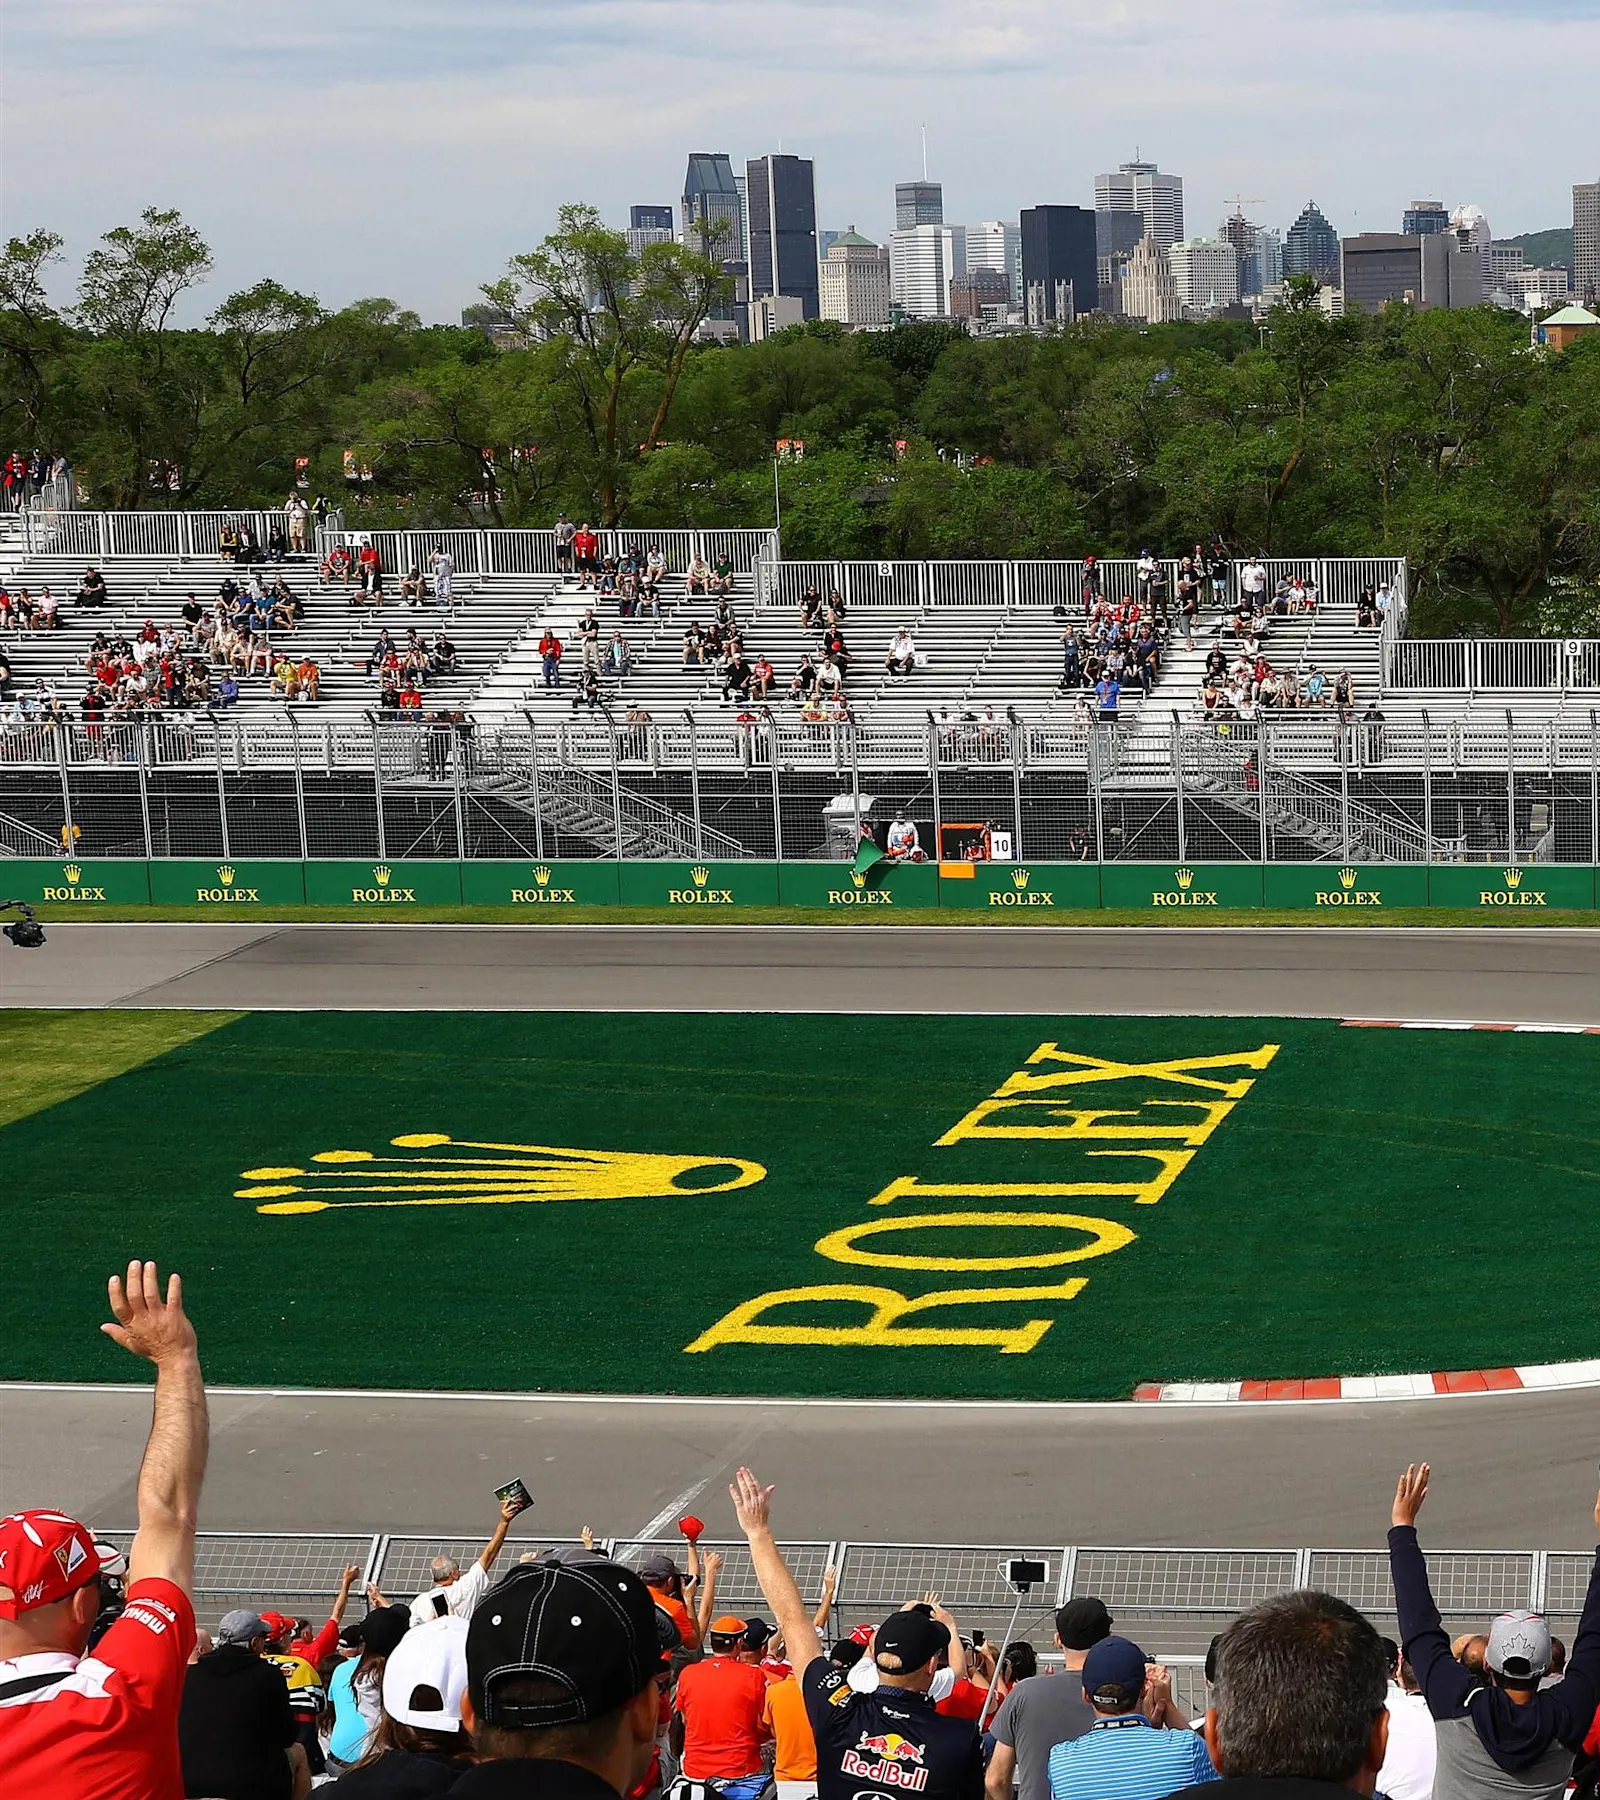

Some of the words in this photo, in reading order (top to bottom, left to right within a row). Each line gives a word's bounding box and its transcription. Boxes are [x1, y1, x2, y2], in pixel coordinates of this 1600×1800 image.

[347, 534, 355, 545] 7
[881, 562, 890, 575] 8
[1568, 641, 1578, 654] 9
[994, 839, 1009, 852] 10
[43, 888, 106, 900] ROLEX
[197, 889, 259, 901] ROLEX
[352, 889, 416, 902] ROLEX
[511, 889, 575, 902] ROLEX
[669, 890, 733, 903] ROLEX
[828, 891, 892, 903] ROLEX
[989, 892, 1054, 905] ROLEX
[1152, 892, 1218, 905] ROLEX
[1315, 892, 1381, 905] ROLEX
[1480, 892, 1547, 905] ROLEX
[683, 1042, 1282, 1354] ROLEX
[840, 1749, 887, 1784] Red
[883, 1759, 929, 1792] Bull
